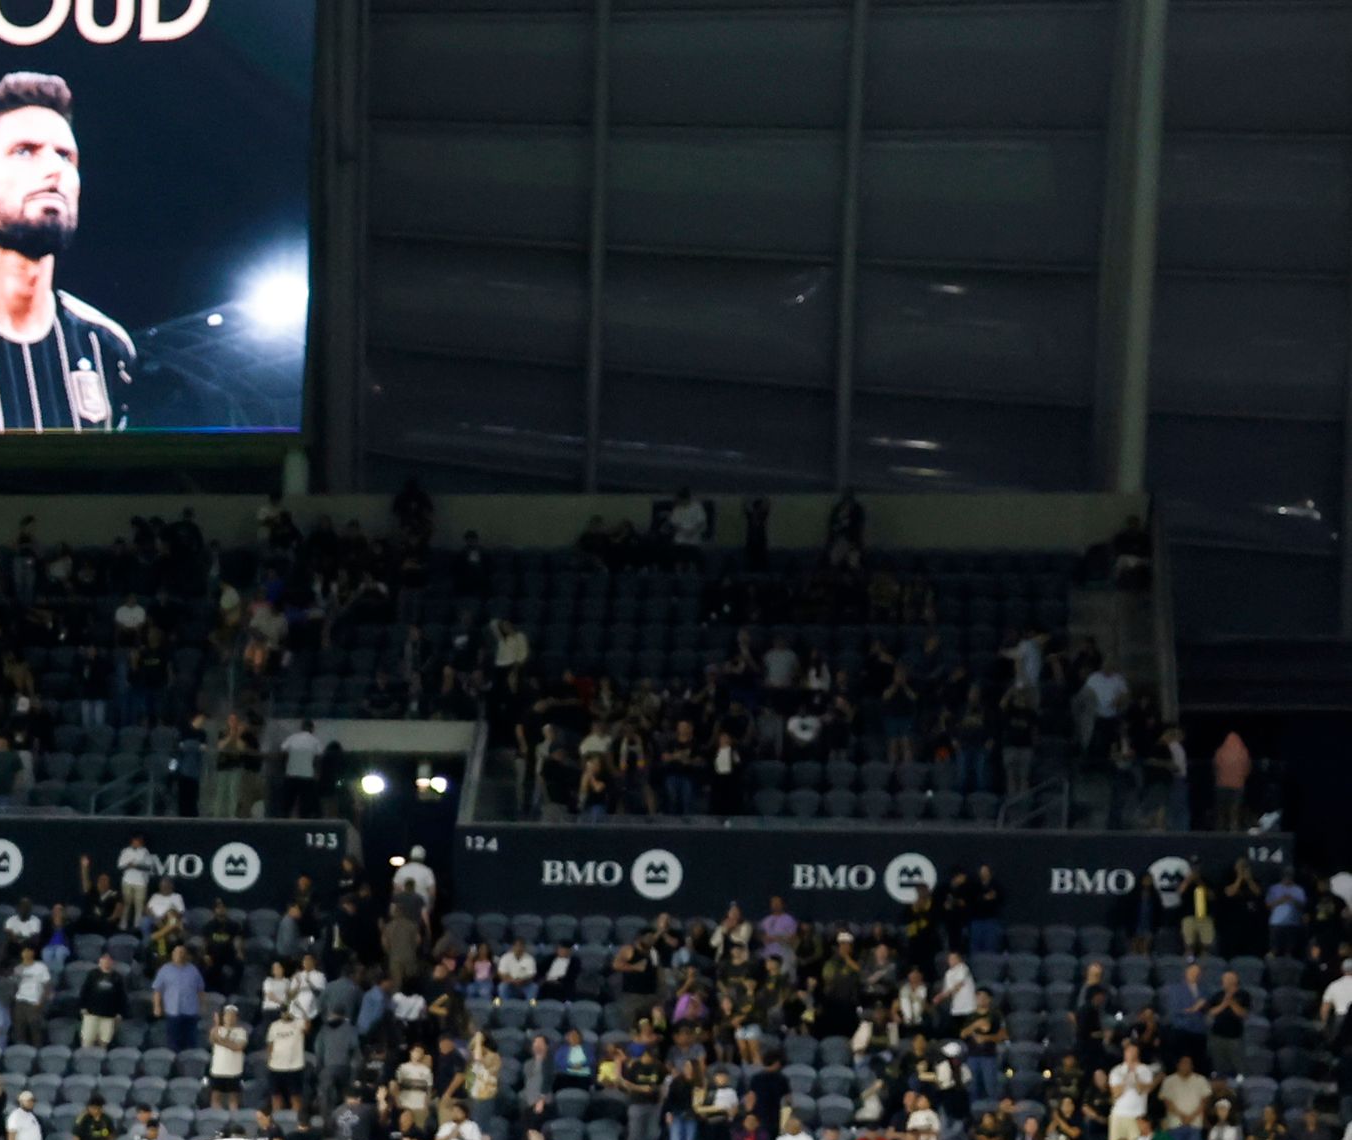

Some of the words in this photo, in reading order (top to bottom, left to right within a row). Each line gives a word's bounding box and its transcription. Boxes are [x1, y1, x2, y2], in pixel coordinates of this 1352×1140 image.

[150, 853, 204, 879] MO
[541, 859, 624, 887] BMO
[792, 864, 877, 892] BMO
[1050, 868, 1136, 896] BMO
